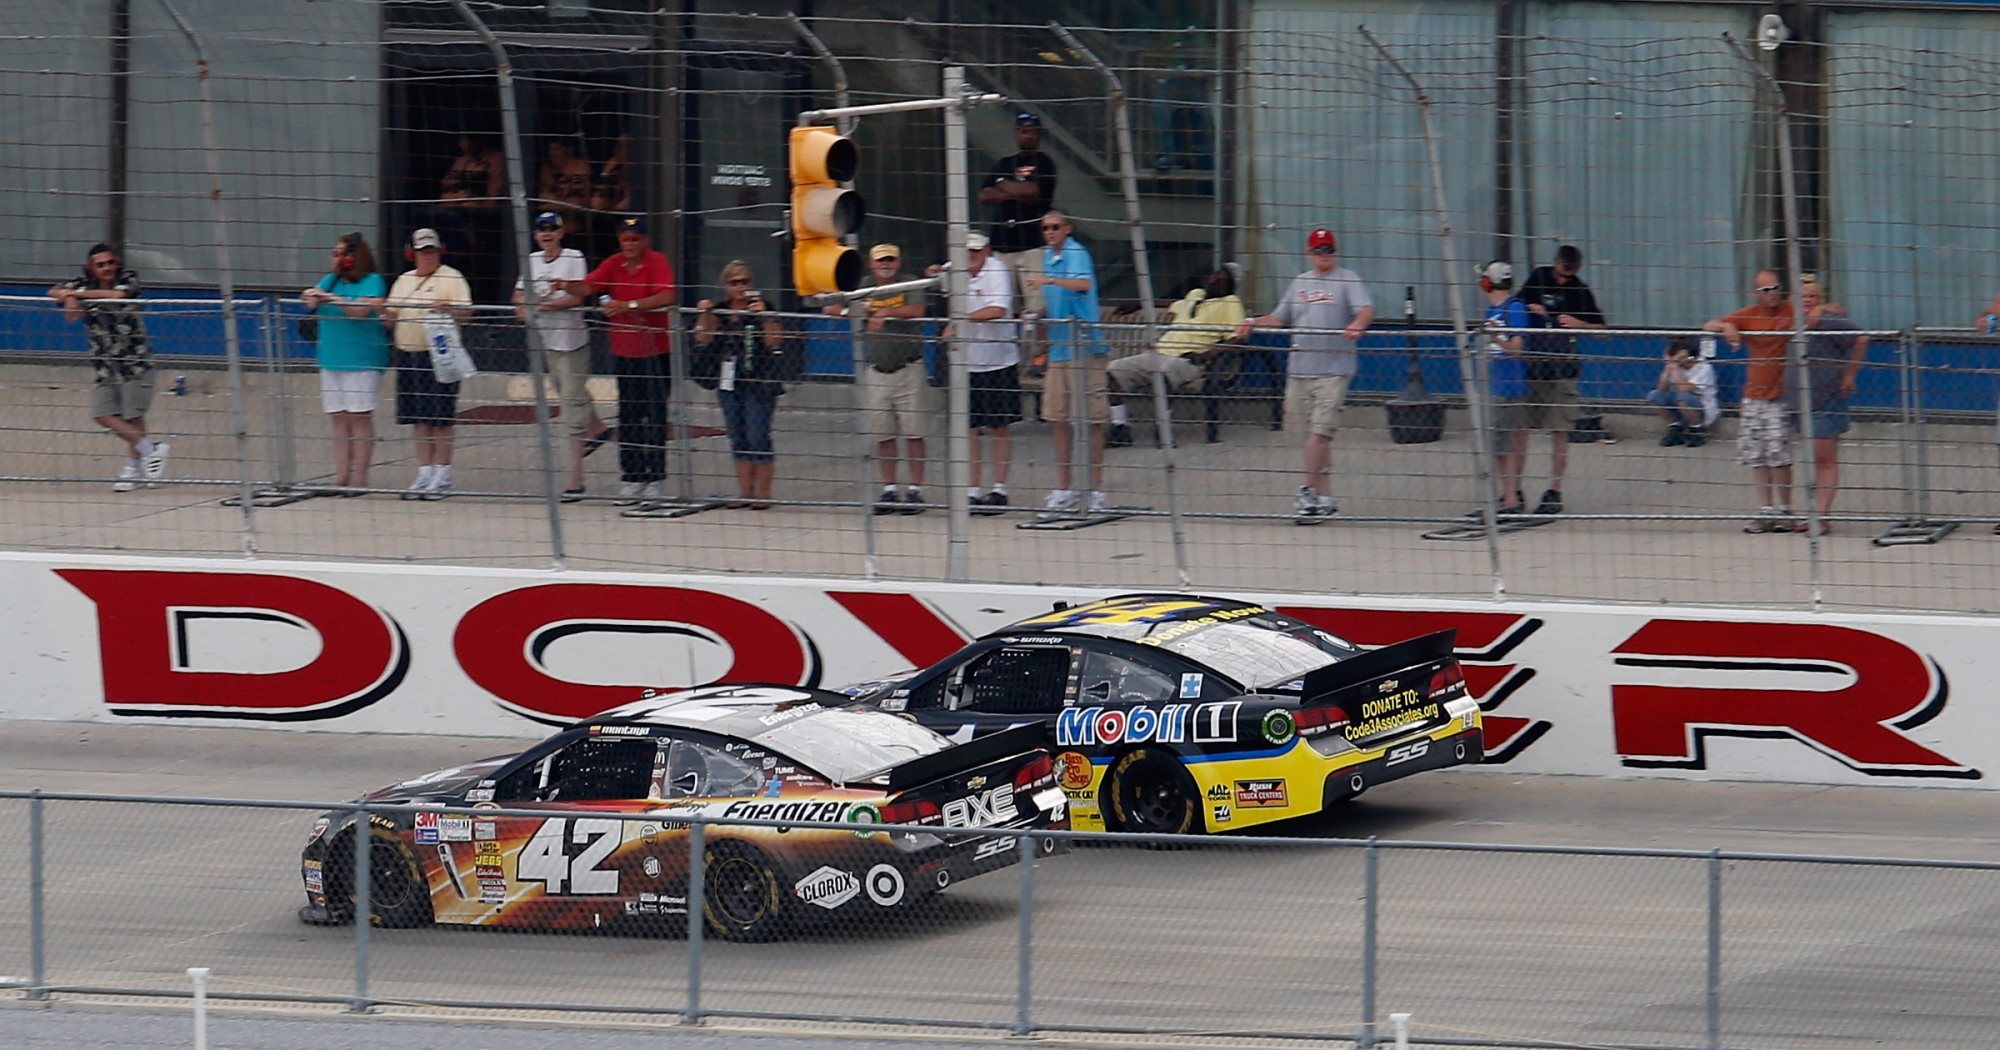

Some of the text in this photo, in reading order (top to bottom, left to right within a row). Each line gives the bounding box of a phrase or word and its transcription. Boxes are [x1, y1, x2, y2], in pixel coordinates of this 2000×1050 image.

[1136, 606, 1266, 646] Donate Now
[1362, 688, 1420, 719] DONATE TO:
[757, 701, 822, 727] Energizer
[1263, 708, 1294, 722] AMERICAN
[1344, 703, 1440, 741] Code3Associates.org
[601, 725, 651, 736] montoya
[1056, 704, 1191, 746] Mobil
[1065, 754, 1083, 765] Bass
[1386, 739, 1430, 767] SS
[774, 767, 795, 775] TUMS
[1067, 764, 1081, 776] Pro
[1068, 774, 1089, 785] Shops
[1082, 790, 1095, 800] CAT
[1207, 783, 1231, 796] MAC
[1239, 790, 1284, 801] TRUCK CENTERS
[942, 783, 1019, 829] AXE
[1050, 803, 1065, 822] 42
[415, 813, 438, 828] 3M
[723, 800, 853, 834] Energizer
[517, 817, 623, 895] 42
[973, 836, 1016, 861] SS
[475, 855, 502, 867] JEGS
[803, 874, 852, 902] CLOROX
